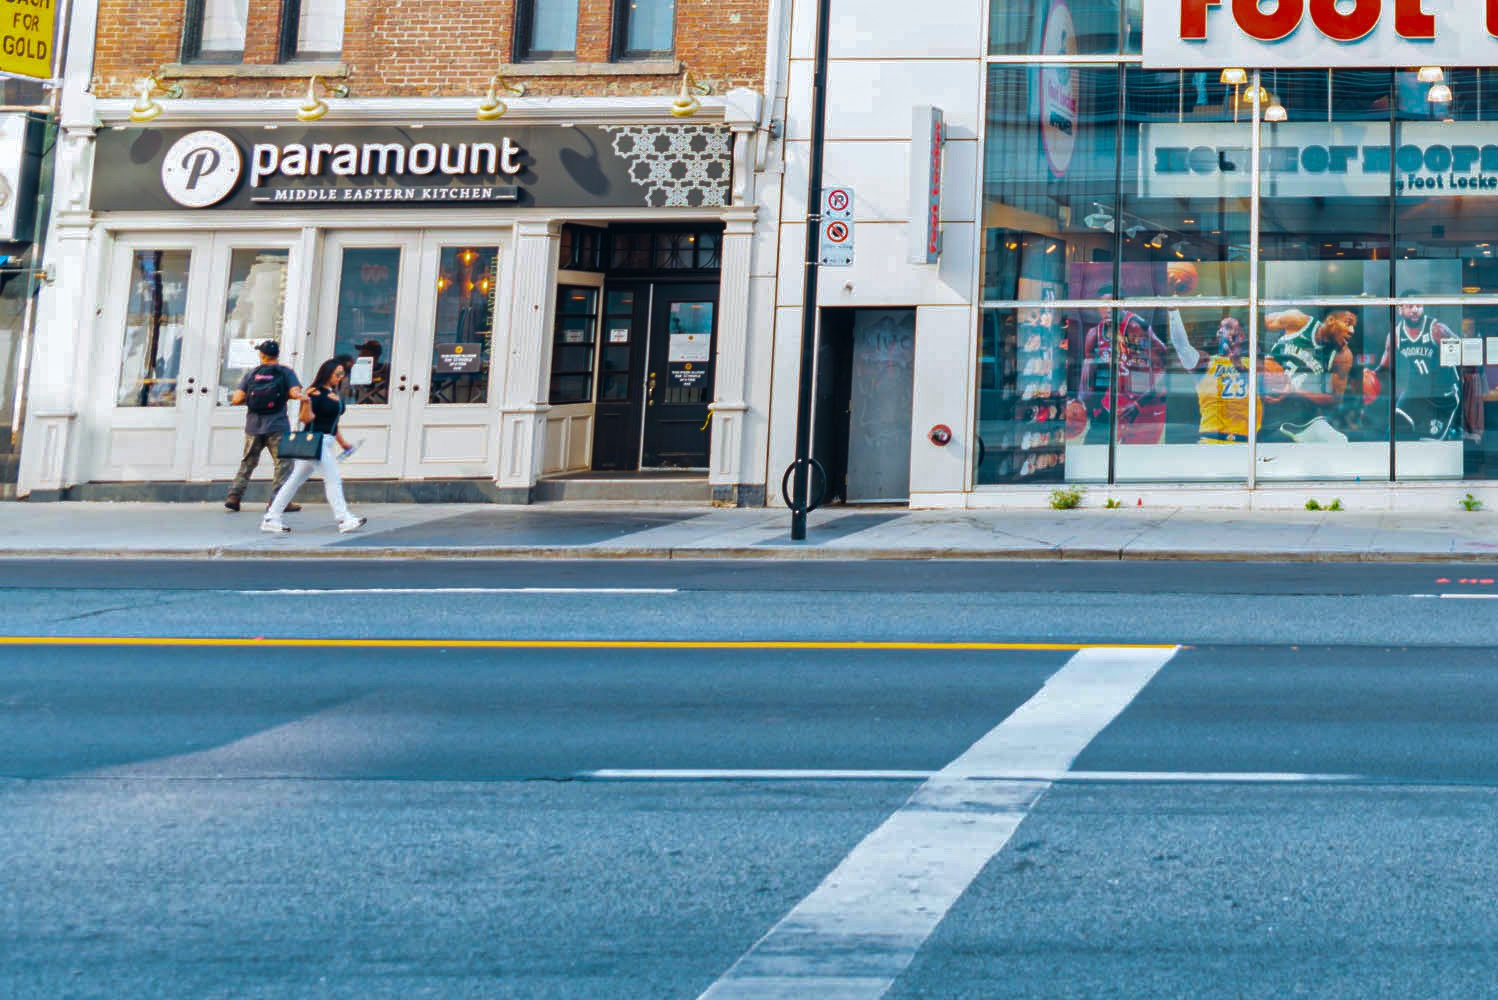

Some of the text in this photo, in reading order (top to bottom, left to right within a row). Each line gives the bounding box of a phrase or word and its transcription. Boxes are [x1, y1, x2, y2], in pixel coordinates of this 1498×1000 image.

[13, 13, 40, 33] FOR
[3, 35, 47, 60] GOLD
[251, 137, 521, 187] paramount
[1408, 173, 1443, 190] Foot
[275, 187, 493, 201] MIDDLE EASTERN KITCHEN
[1414, 359, 1430, 375] 11
[1221, 376, 1248, 398] 23
